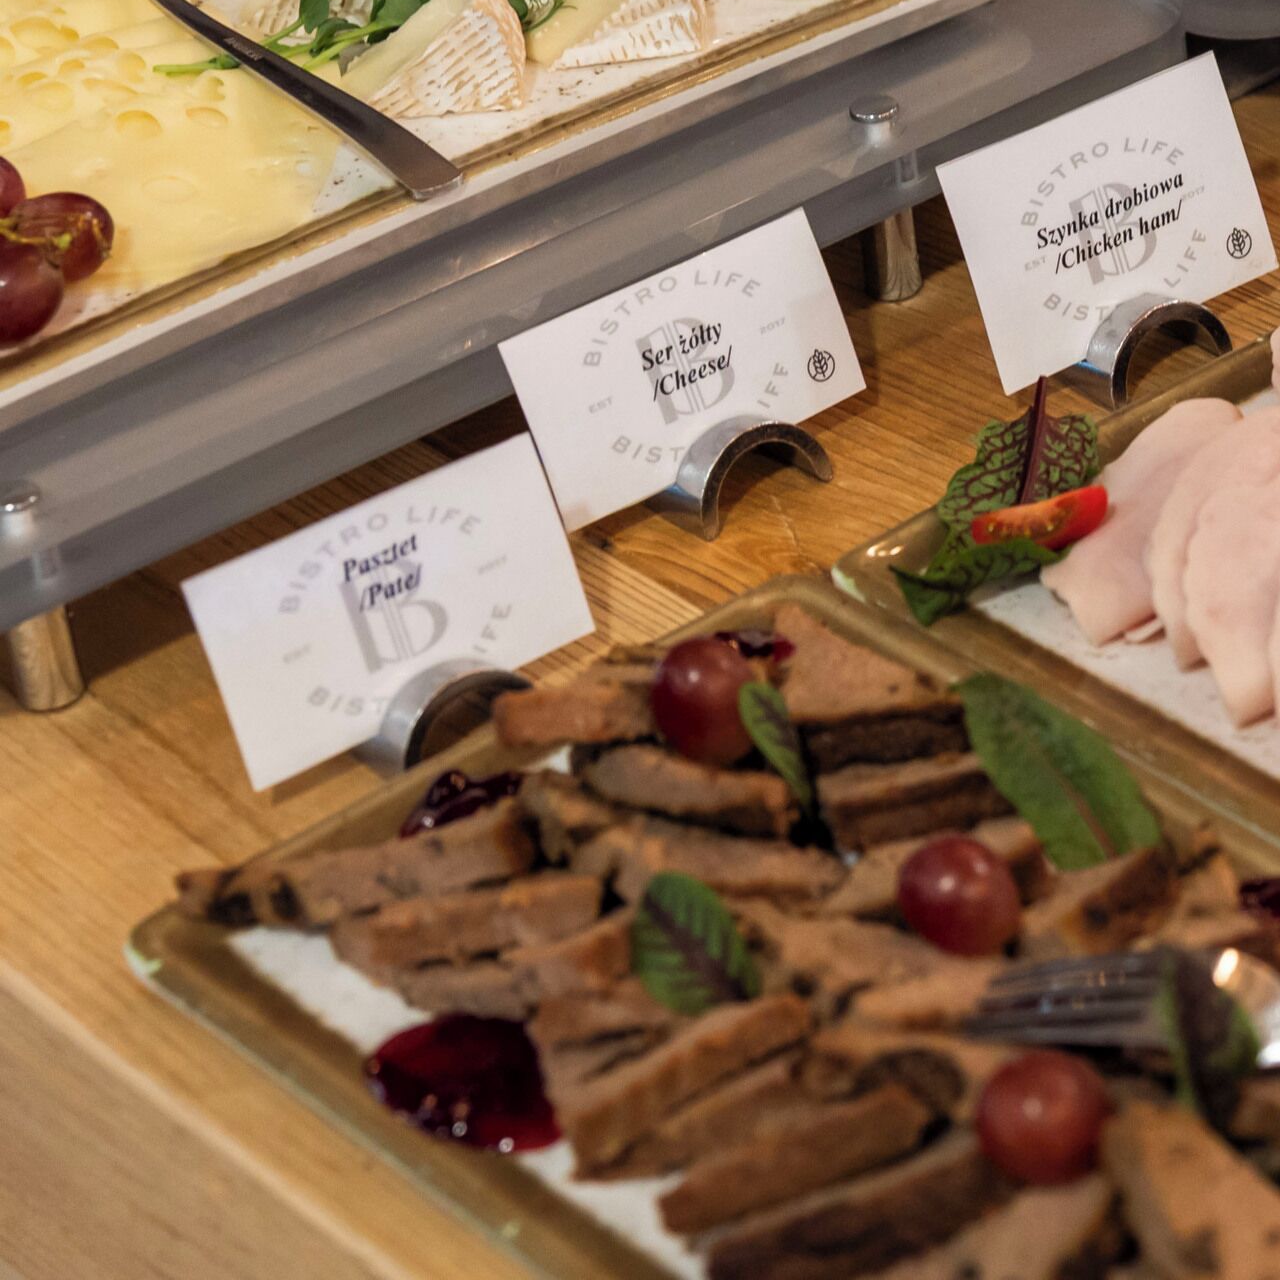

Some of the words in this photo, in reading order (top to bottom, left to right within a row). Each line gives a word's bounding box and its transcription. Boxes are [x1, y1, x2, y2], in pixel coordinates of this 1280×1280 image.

[1021, 142, 1109, 228] BISTRO
[1123, 137, 1184, 166] LIFE
[1036, 209, 1100, 250] Szynka
[1104, 173, 1185, 220] drobiowa
[1043, 293, 1112, 322] BIST
[1163, 229, 1207, 288] LIFE
[1055, 228, 1134, 275] /Chicken
[1139, 199, 1184, 236] ham/
[583, 276, 677, 368] BISTRO
[694, 269, 761, 298] LIFE
[641, 344, 673, 372] Ser
[679, 322, 722, 355] żółty
[611, 435, 686, 464] BIST
[757, 362, 790, 410] IFE
[653, 345, 732, 402] /Cheese/
[278, 513, 389, 614] BISTRO
[407, 505, 481, 536] LIFE
[342, 534, 419, 583] Pasztet
